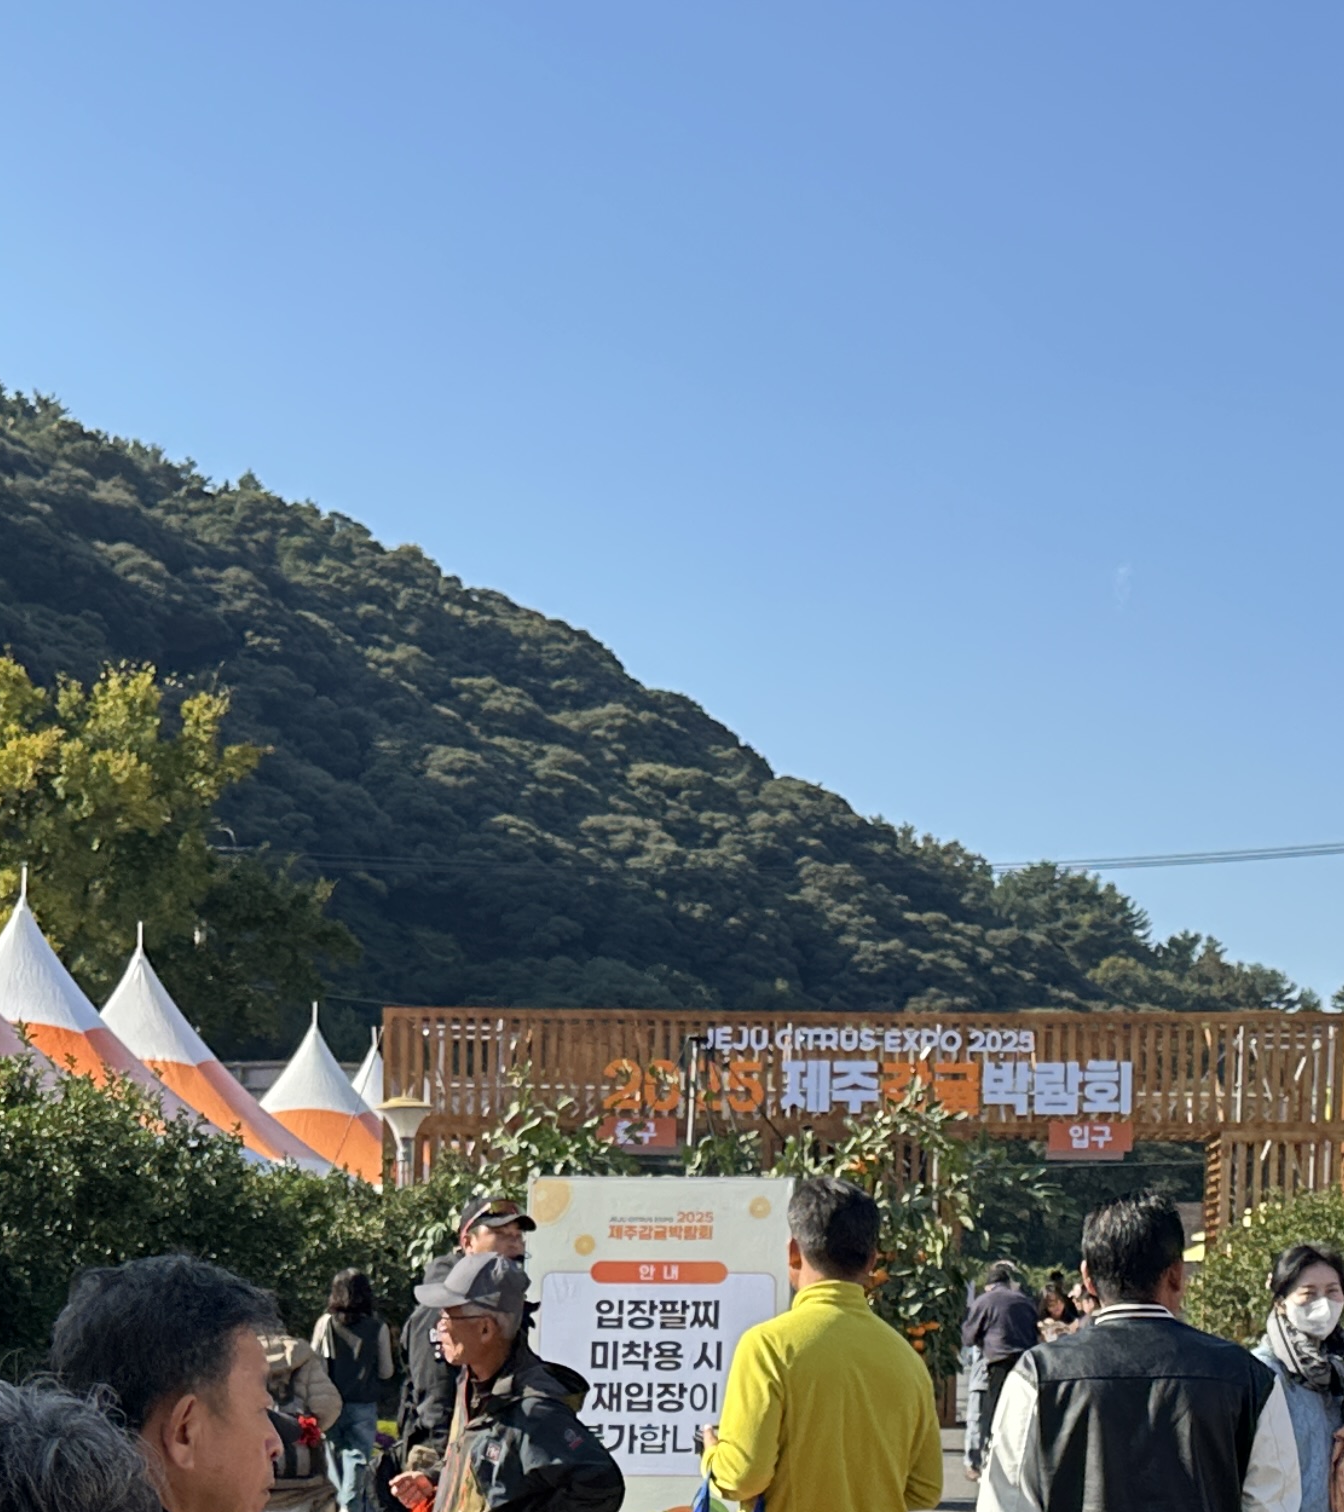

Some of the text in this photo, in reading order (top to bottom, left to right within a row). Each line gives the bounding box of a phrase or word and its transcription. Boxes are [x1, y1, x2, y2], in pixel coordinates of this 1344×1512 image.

[701, 1026, 1035, 1053] JEJU CITRUS EXPO 2025
[1068, 1124, 1113, 1149] 입구
[677, 1211, 714, 1224] 2025
[595, 1299, 720, 1330] 입장팔찌
[590, 1340, 723, 1371] 미착용 시
[591, 1382, 718, 1413] 재입장이
